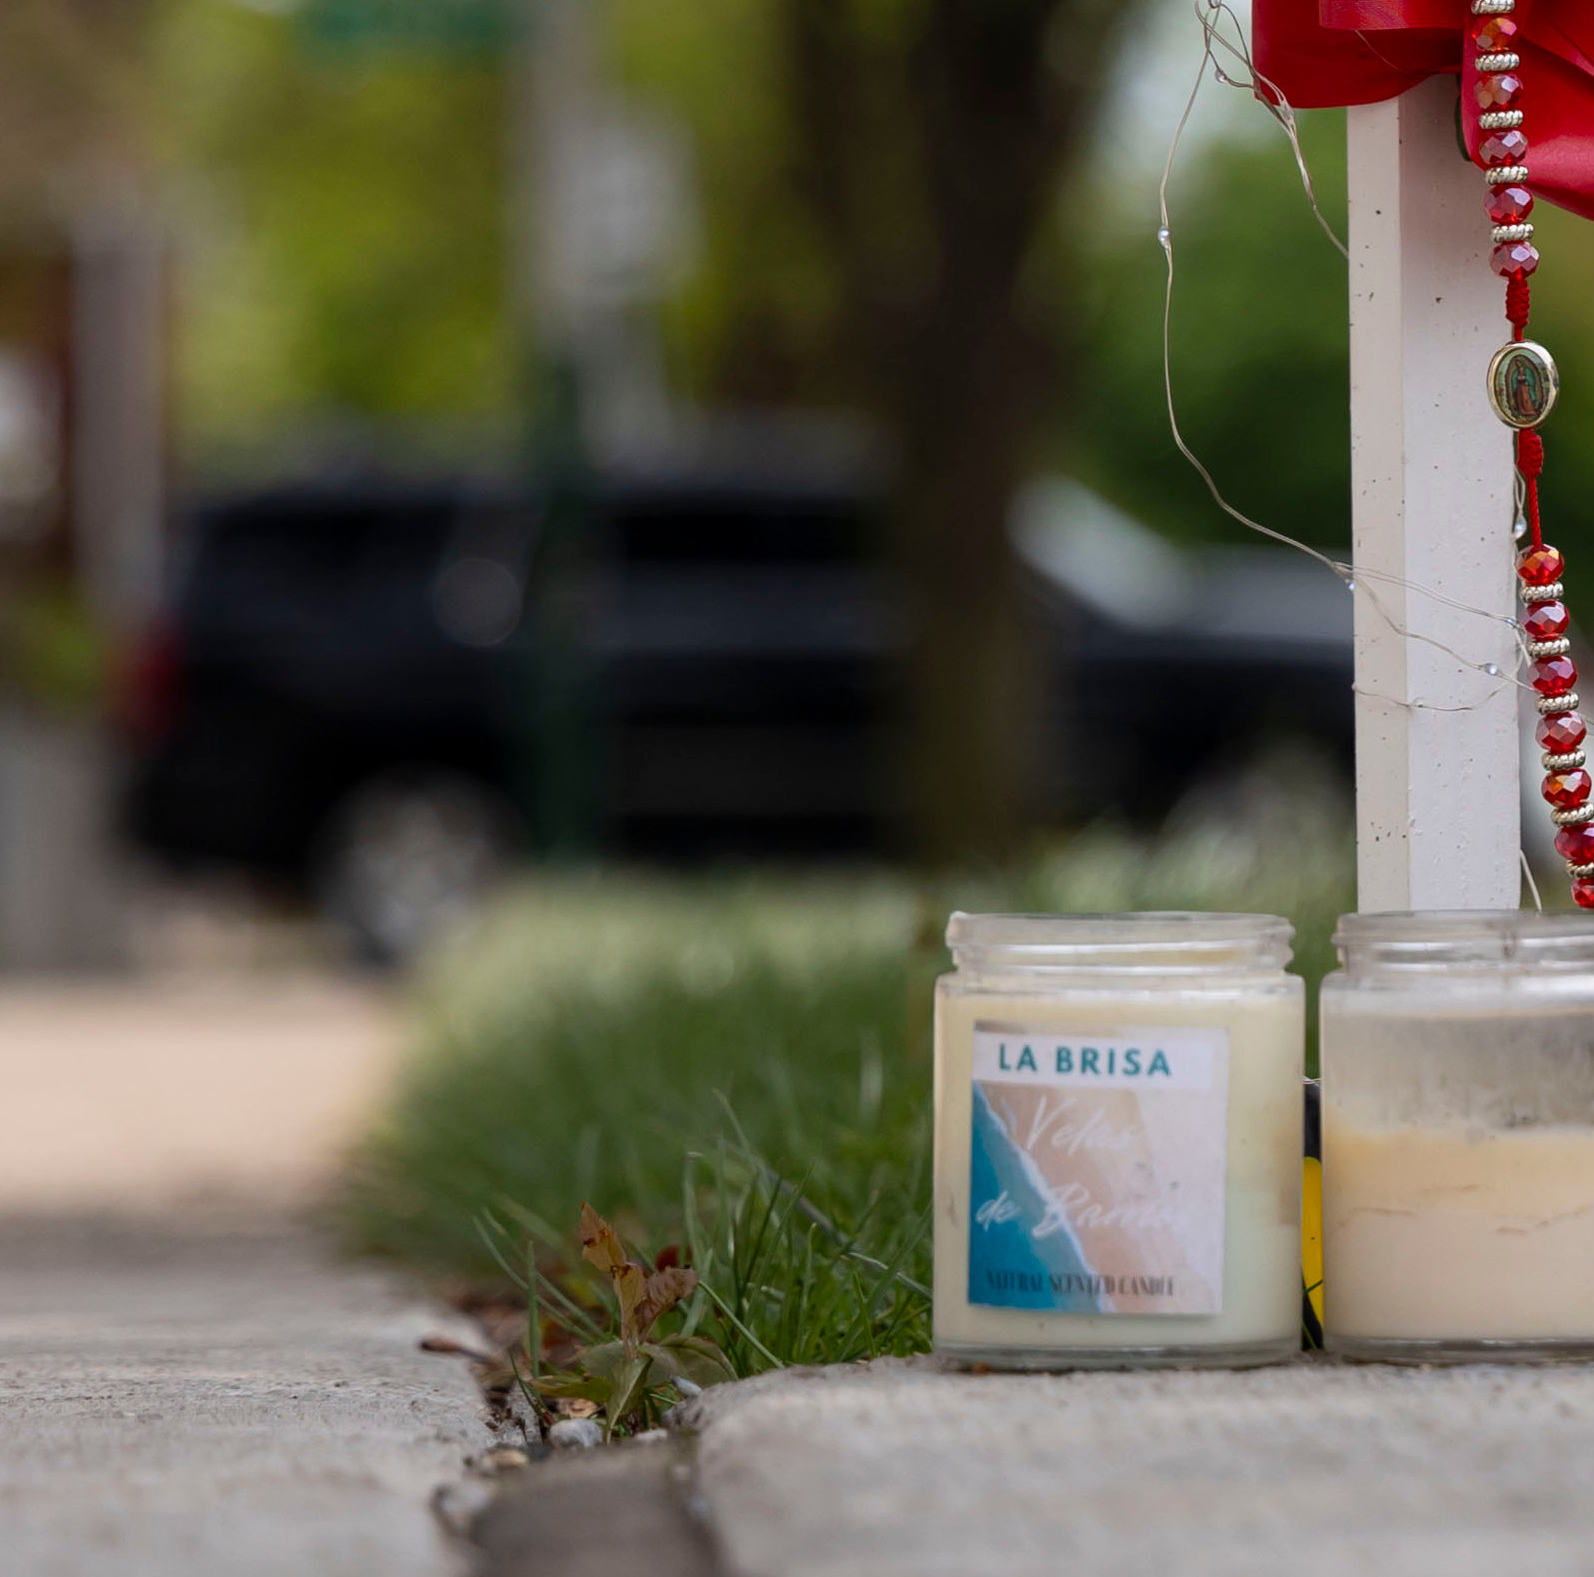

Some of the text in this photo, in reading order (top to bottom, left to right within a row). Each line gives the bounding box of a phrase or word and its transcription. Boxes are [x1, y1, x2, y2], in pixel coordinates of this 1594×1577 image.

[999, 1043, 1172, 1077] LA BRISA
[974, 1190, 1021, 1232] de
